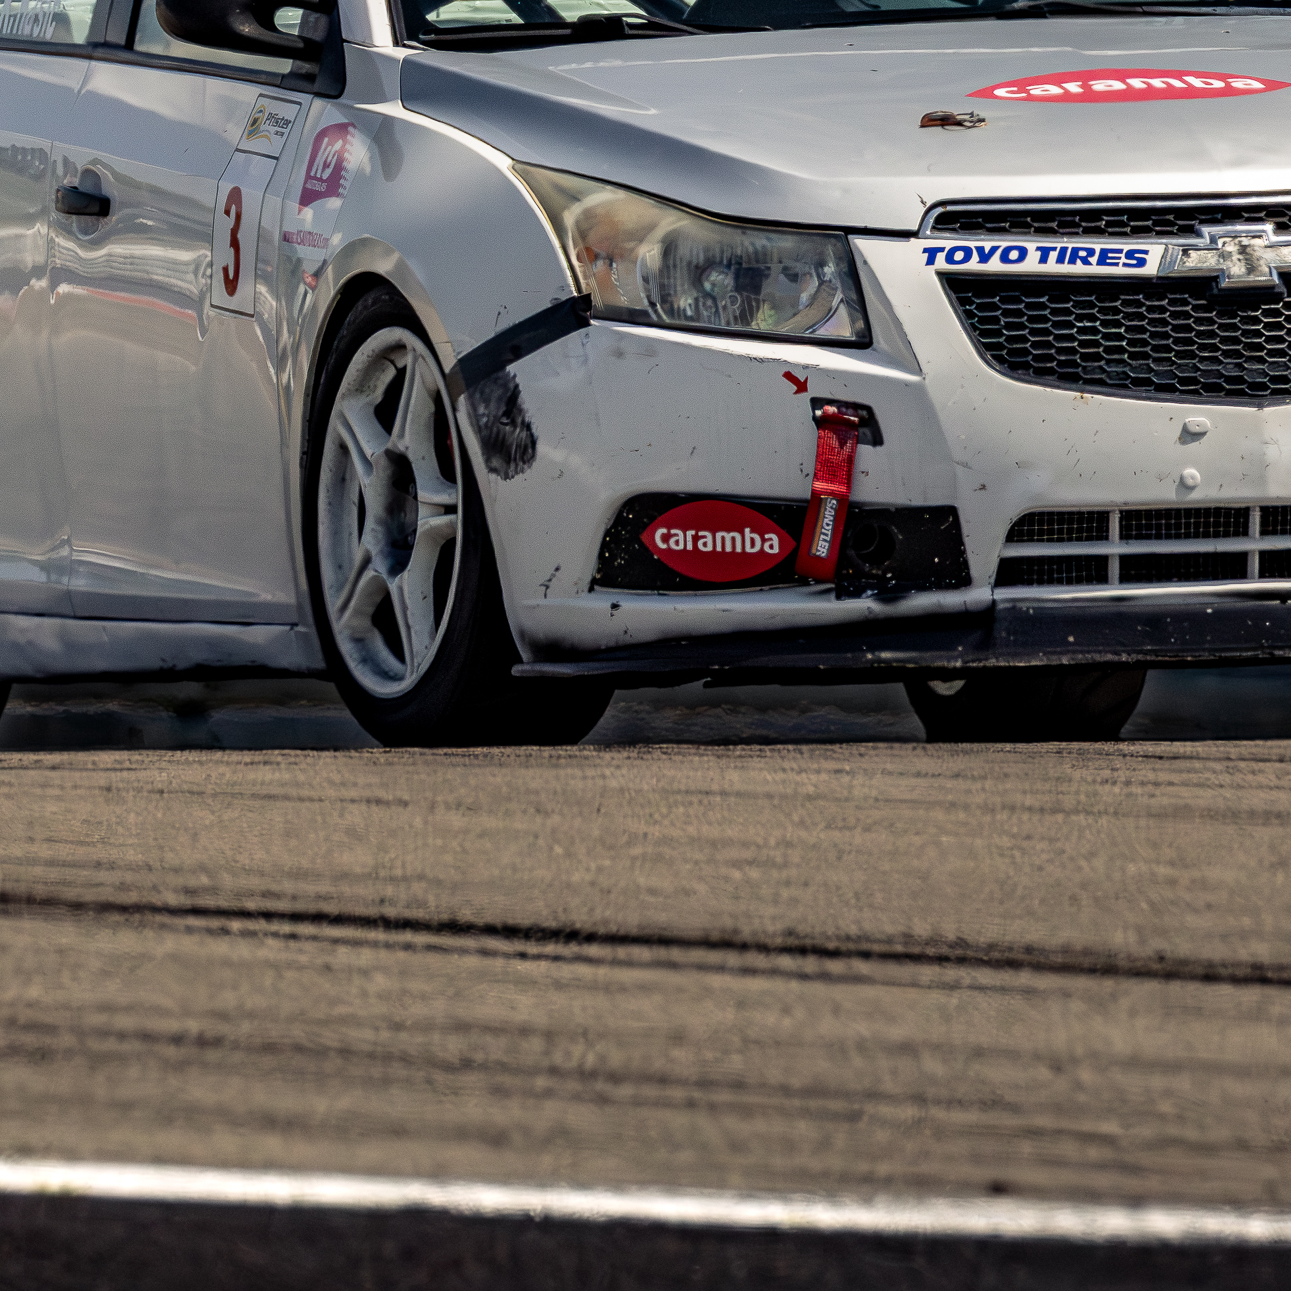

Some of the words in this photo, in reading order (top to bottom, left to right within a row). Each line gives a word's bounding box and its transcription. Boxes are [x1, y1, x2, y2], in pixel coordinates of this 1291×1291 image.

[992, 75, 1267, 99] caramba
[263, 112, 292, 129] Pfister
[221, 185, 243, 297] 3
[921, 245, 1029, 267] TOYO
[1034, 245, 1150, 269] TIRES
[816, 498, 837, 557] SANDTLER
[654, 527, 780, 555] caramba
